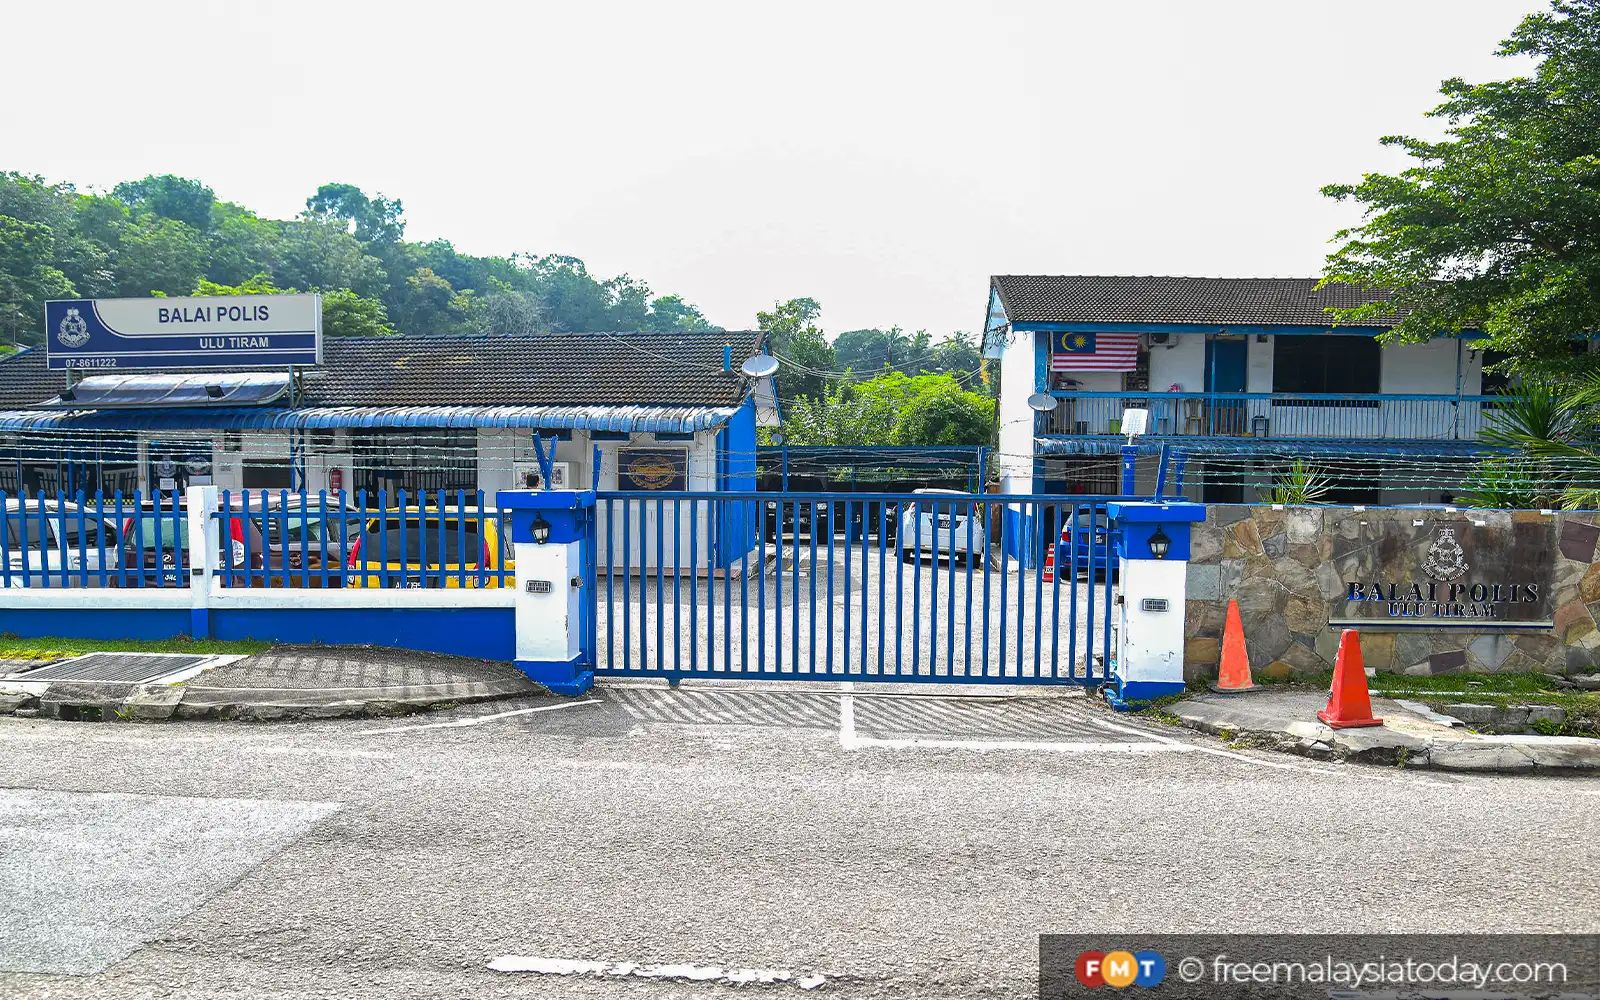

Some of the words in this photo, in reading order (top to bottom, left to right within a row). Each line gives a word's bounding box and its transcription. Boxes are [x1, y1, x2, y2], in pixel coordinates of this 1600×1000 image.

[158, 307, 211, 323] BALAI
[217, 305, 270, 322] POLIS
[199, 338, 225, 349] ULU
[228, 337, 269, 348] TIRAM
[65, 358, 117, 368] 07-8611222
[1346, 582, 1438, 602] BALAI
[1448, 583, 1539, 604] POLIS
[1387, 602, 1427, 617] ULU
[1431, 602, 1497, 618] TIRAM
